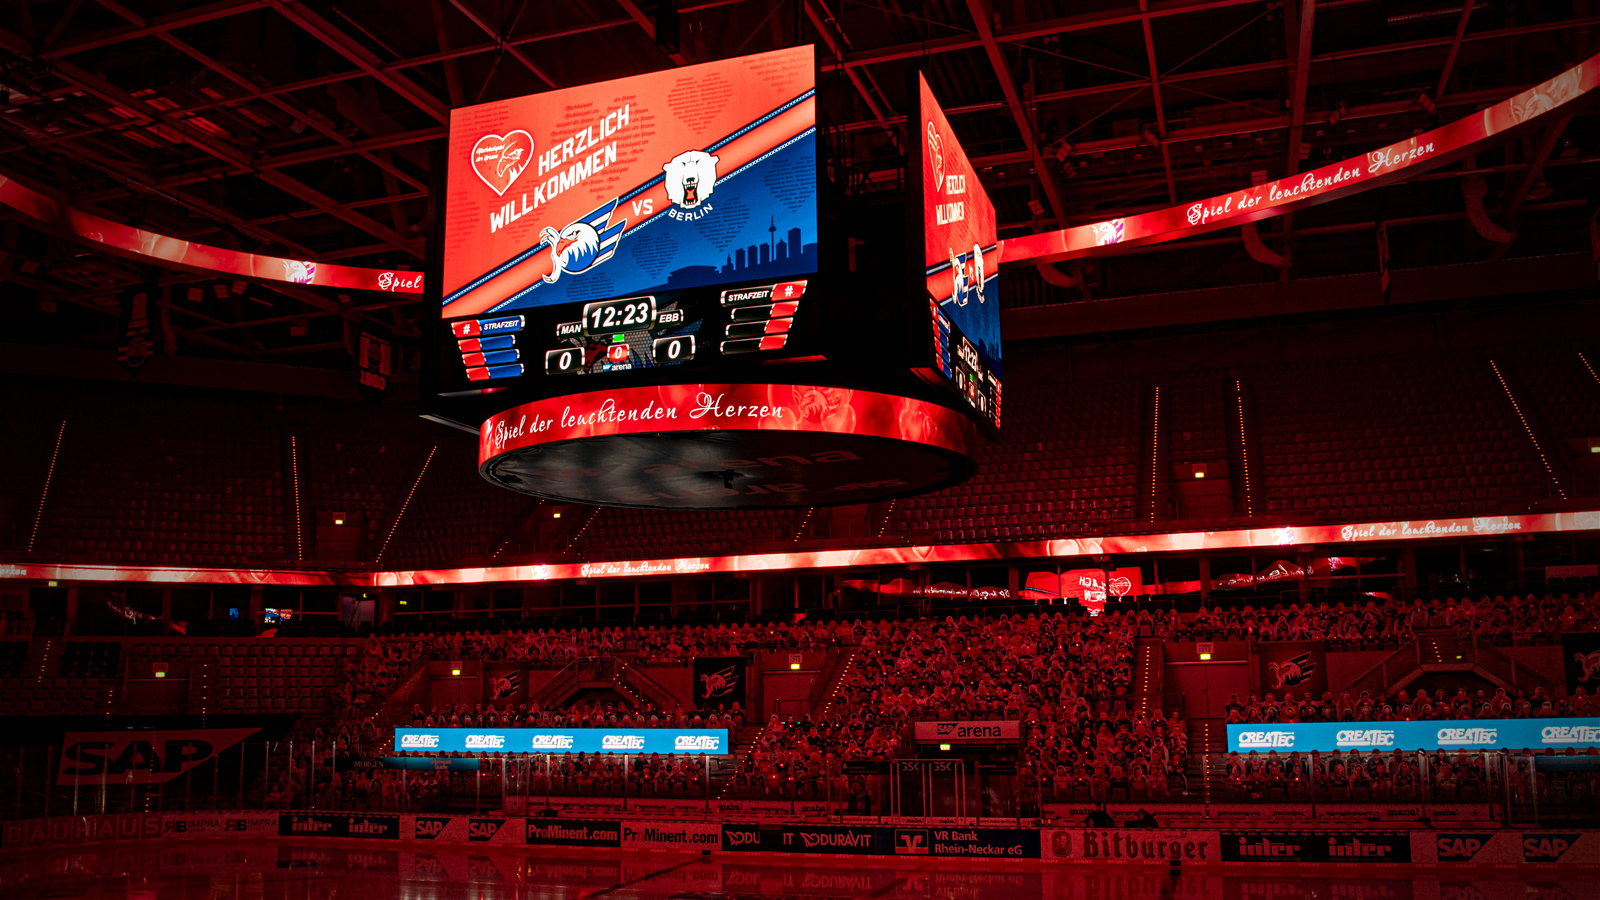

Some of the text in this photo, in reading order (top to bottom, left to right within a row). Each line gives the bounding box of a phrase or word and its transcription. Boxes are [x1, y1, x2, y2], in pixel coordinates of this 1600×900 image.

[538, 103, 630, 177] HERZLICH
[489, 140, 617, 234] WILLKOMMEN
[1187, 139, 1436, 225] Spiel der leuchtenden Herzen
[631, 198, 654, 217] VS
[668, 203, 714, 222] BERLIN
[377, 271, 423, 293] Spiel
[728, 285, 793, 302] STRAFZEIT #
[591, 302, 649, 329] 12:23
[659, 312, 679, 324] EBB
[463, 319, 520, 335] # STRAFZEIT
[561, 324, 582, 335] MAN
[613, 346, 623, 359] 0
[667, 340, 681, 359] 0
[559, 352, 572, 370] 0
[494, 391, 784, 449] Spiel der leuchtenden Herzen
[1341, 525, 1375, 541] Spiel
[1378, 527, 1397, 537] der
[1401, 520, 1468, 536] leuchtenden
[0, 568, 27, 576] erzen
[580, 564, 605, 577] Spiel
[607, 565, 621, 573] der
[957, 726, 1001, 737] arena
[1238, 731, 1294, 747] CREATEC
[1336, 729, 1394, 746] CREATEC
[1437, 727, 1497, 744] CREATEC
[401, 734, 439, 748] CREATEC
[465, 735, 505, 749] CREATEC
[532, 735, 573, 749] CREATEC
[602, 735, 645, 750] CREATEC
[674, 735, 719, 750] CREATEC
[62, 739, 213, 776] SAP
[7, 817, 159, 844] BAUHAUS
[187, 819, 220, 828] IMPRA
[247, 819, 277, 827] IMPRA
[291, 816, 332, 832] inter
[348, 817, 388, 834] inter
[416, 820, 443, 835] SAP
[469, 822, 497, 838] SAP
[933, 830, 978, 842] VR Bank
[934, 843, 1023, 856] Rhein-Neckar eG
[1082, 831, 1209, 860] Bitburger
[1238, 836, 1300, 856] inter
[1328, 836, 1392, 857] inter
[1437, 837, 1481, 858] SAP
[1523, 837, 1569, 858] SAP
